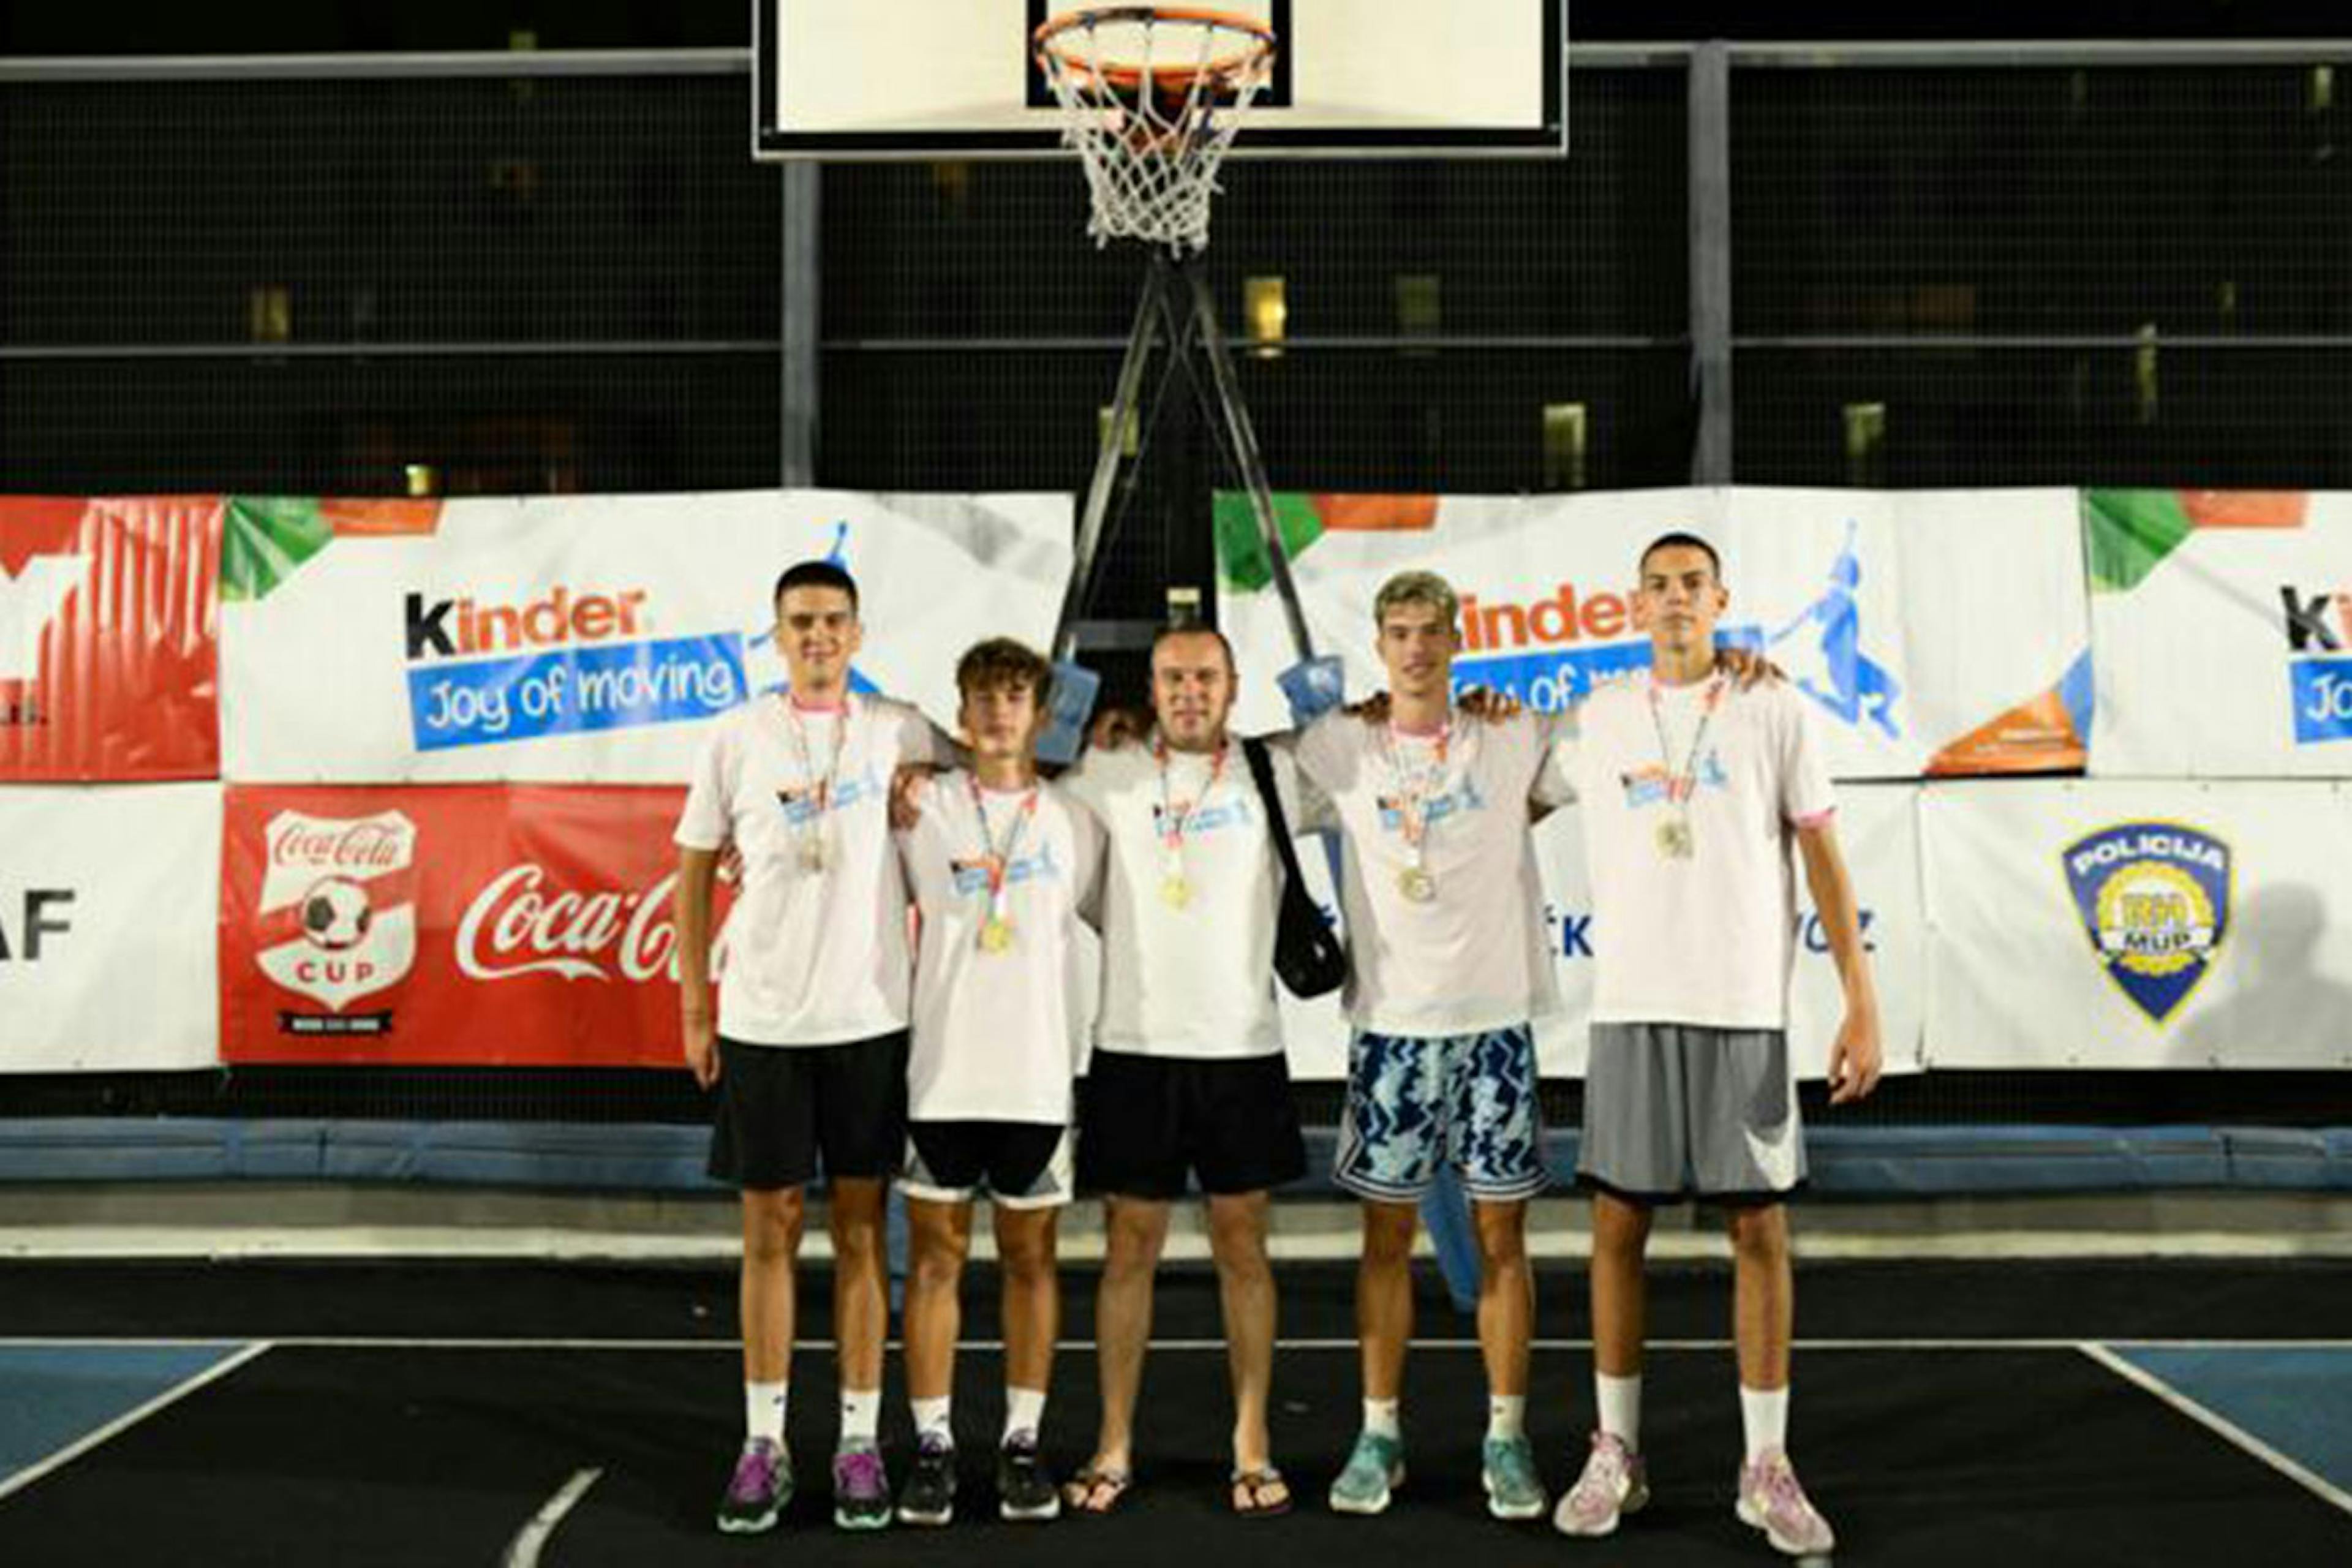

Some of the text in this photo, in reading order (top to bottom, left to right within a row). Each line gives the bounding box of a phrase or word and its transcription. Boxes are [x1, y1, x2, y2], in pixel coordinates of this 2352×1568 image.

[1460, 583, 1643, 650] inde
[521, 664, 567, 718] of
[578, 653, 735, 712] moving
[2073, 835, 2223, 875] POLICIJA
[2125, 930, 2192, 953] MUP
[296, 962, 374, 982] CUP
